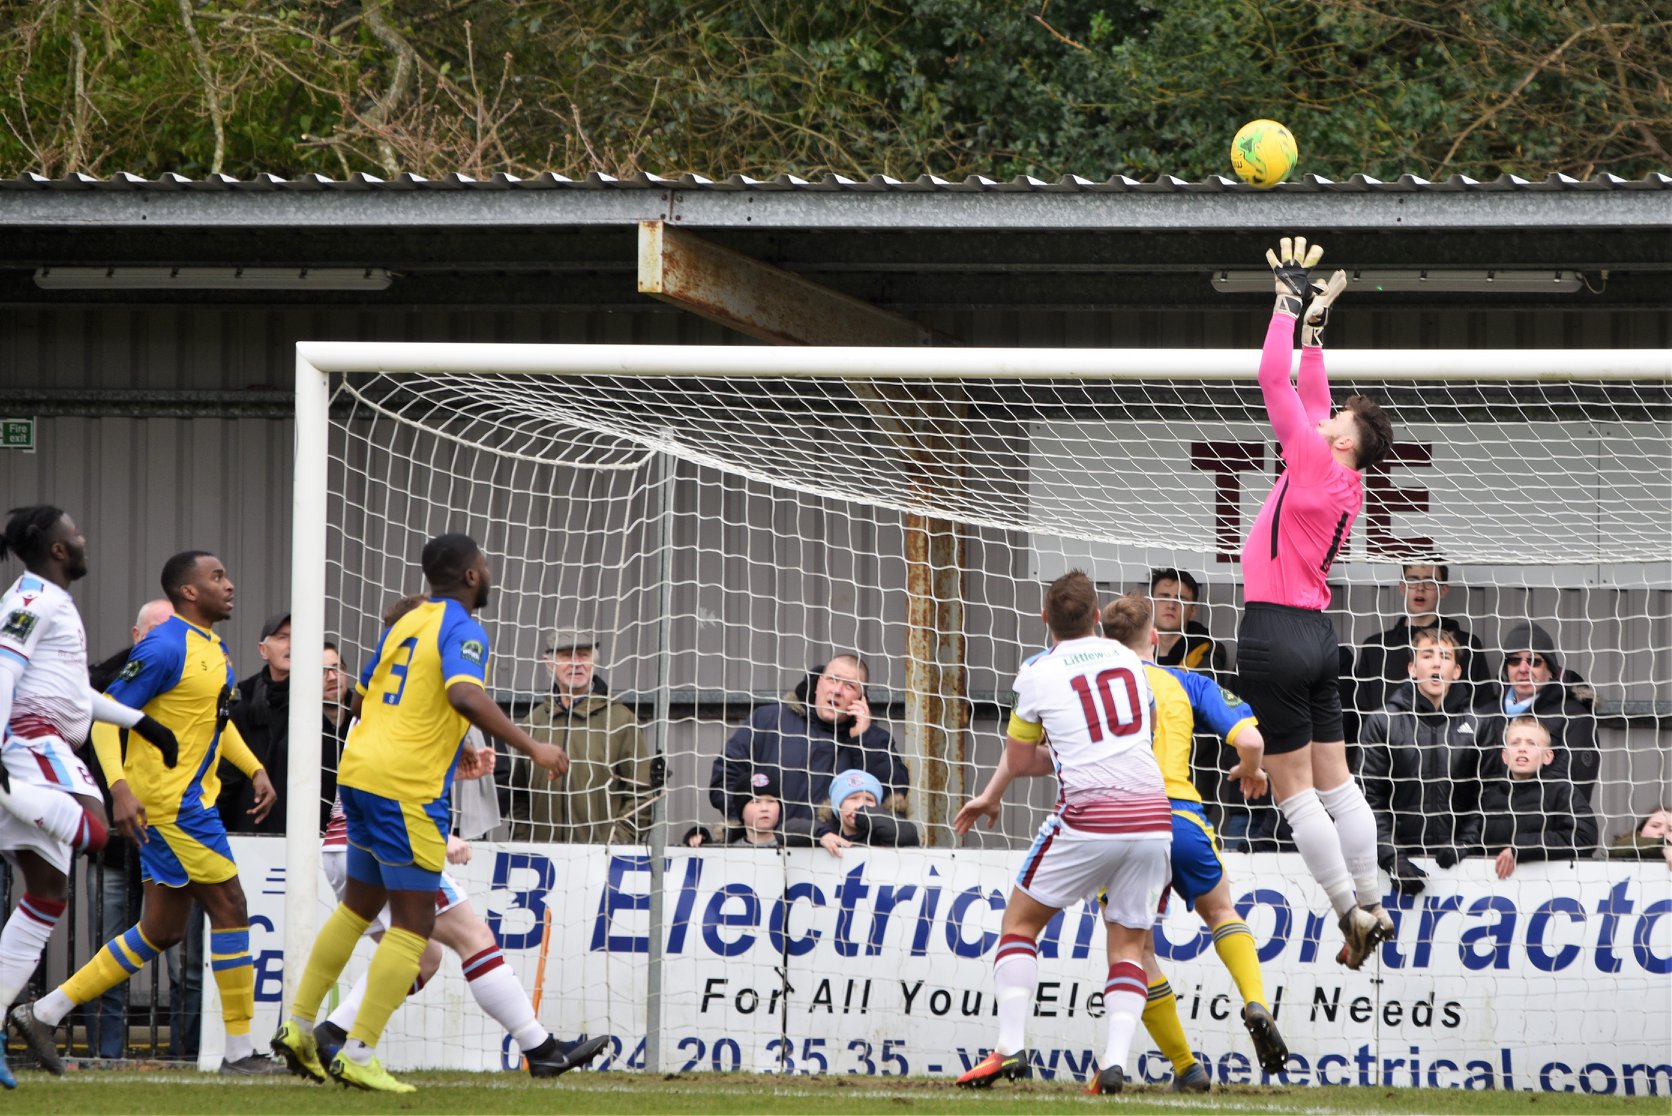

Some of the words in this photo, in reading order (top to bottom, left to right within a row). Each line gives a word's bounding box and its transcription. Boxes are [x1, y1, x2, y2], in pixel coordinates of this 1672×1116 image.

[9, 424, 28, 433] Fire
[9, 434, 27, 443] exit
[1191, 441, 1435, 563] TE
[382, 636, 420, 706] 3
[1070, 667, 1143, 743] 10
[700, 978, 785, 1015] For
[808, 978, 871, 1015] All
[1310, 985, 1462, 1028] Needs
[677, 1036, 742, 1073] 20
[764, 1038, 828, 1076] 35
[847, 1038, 910, 1077] 35
